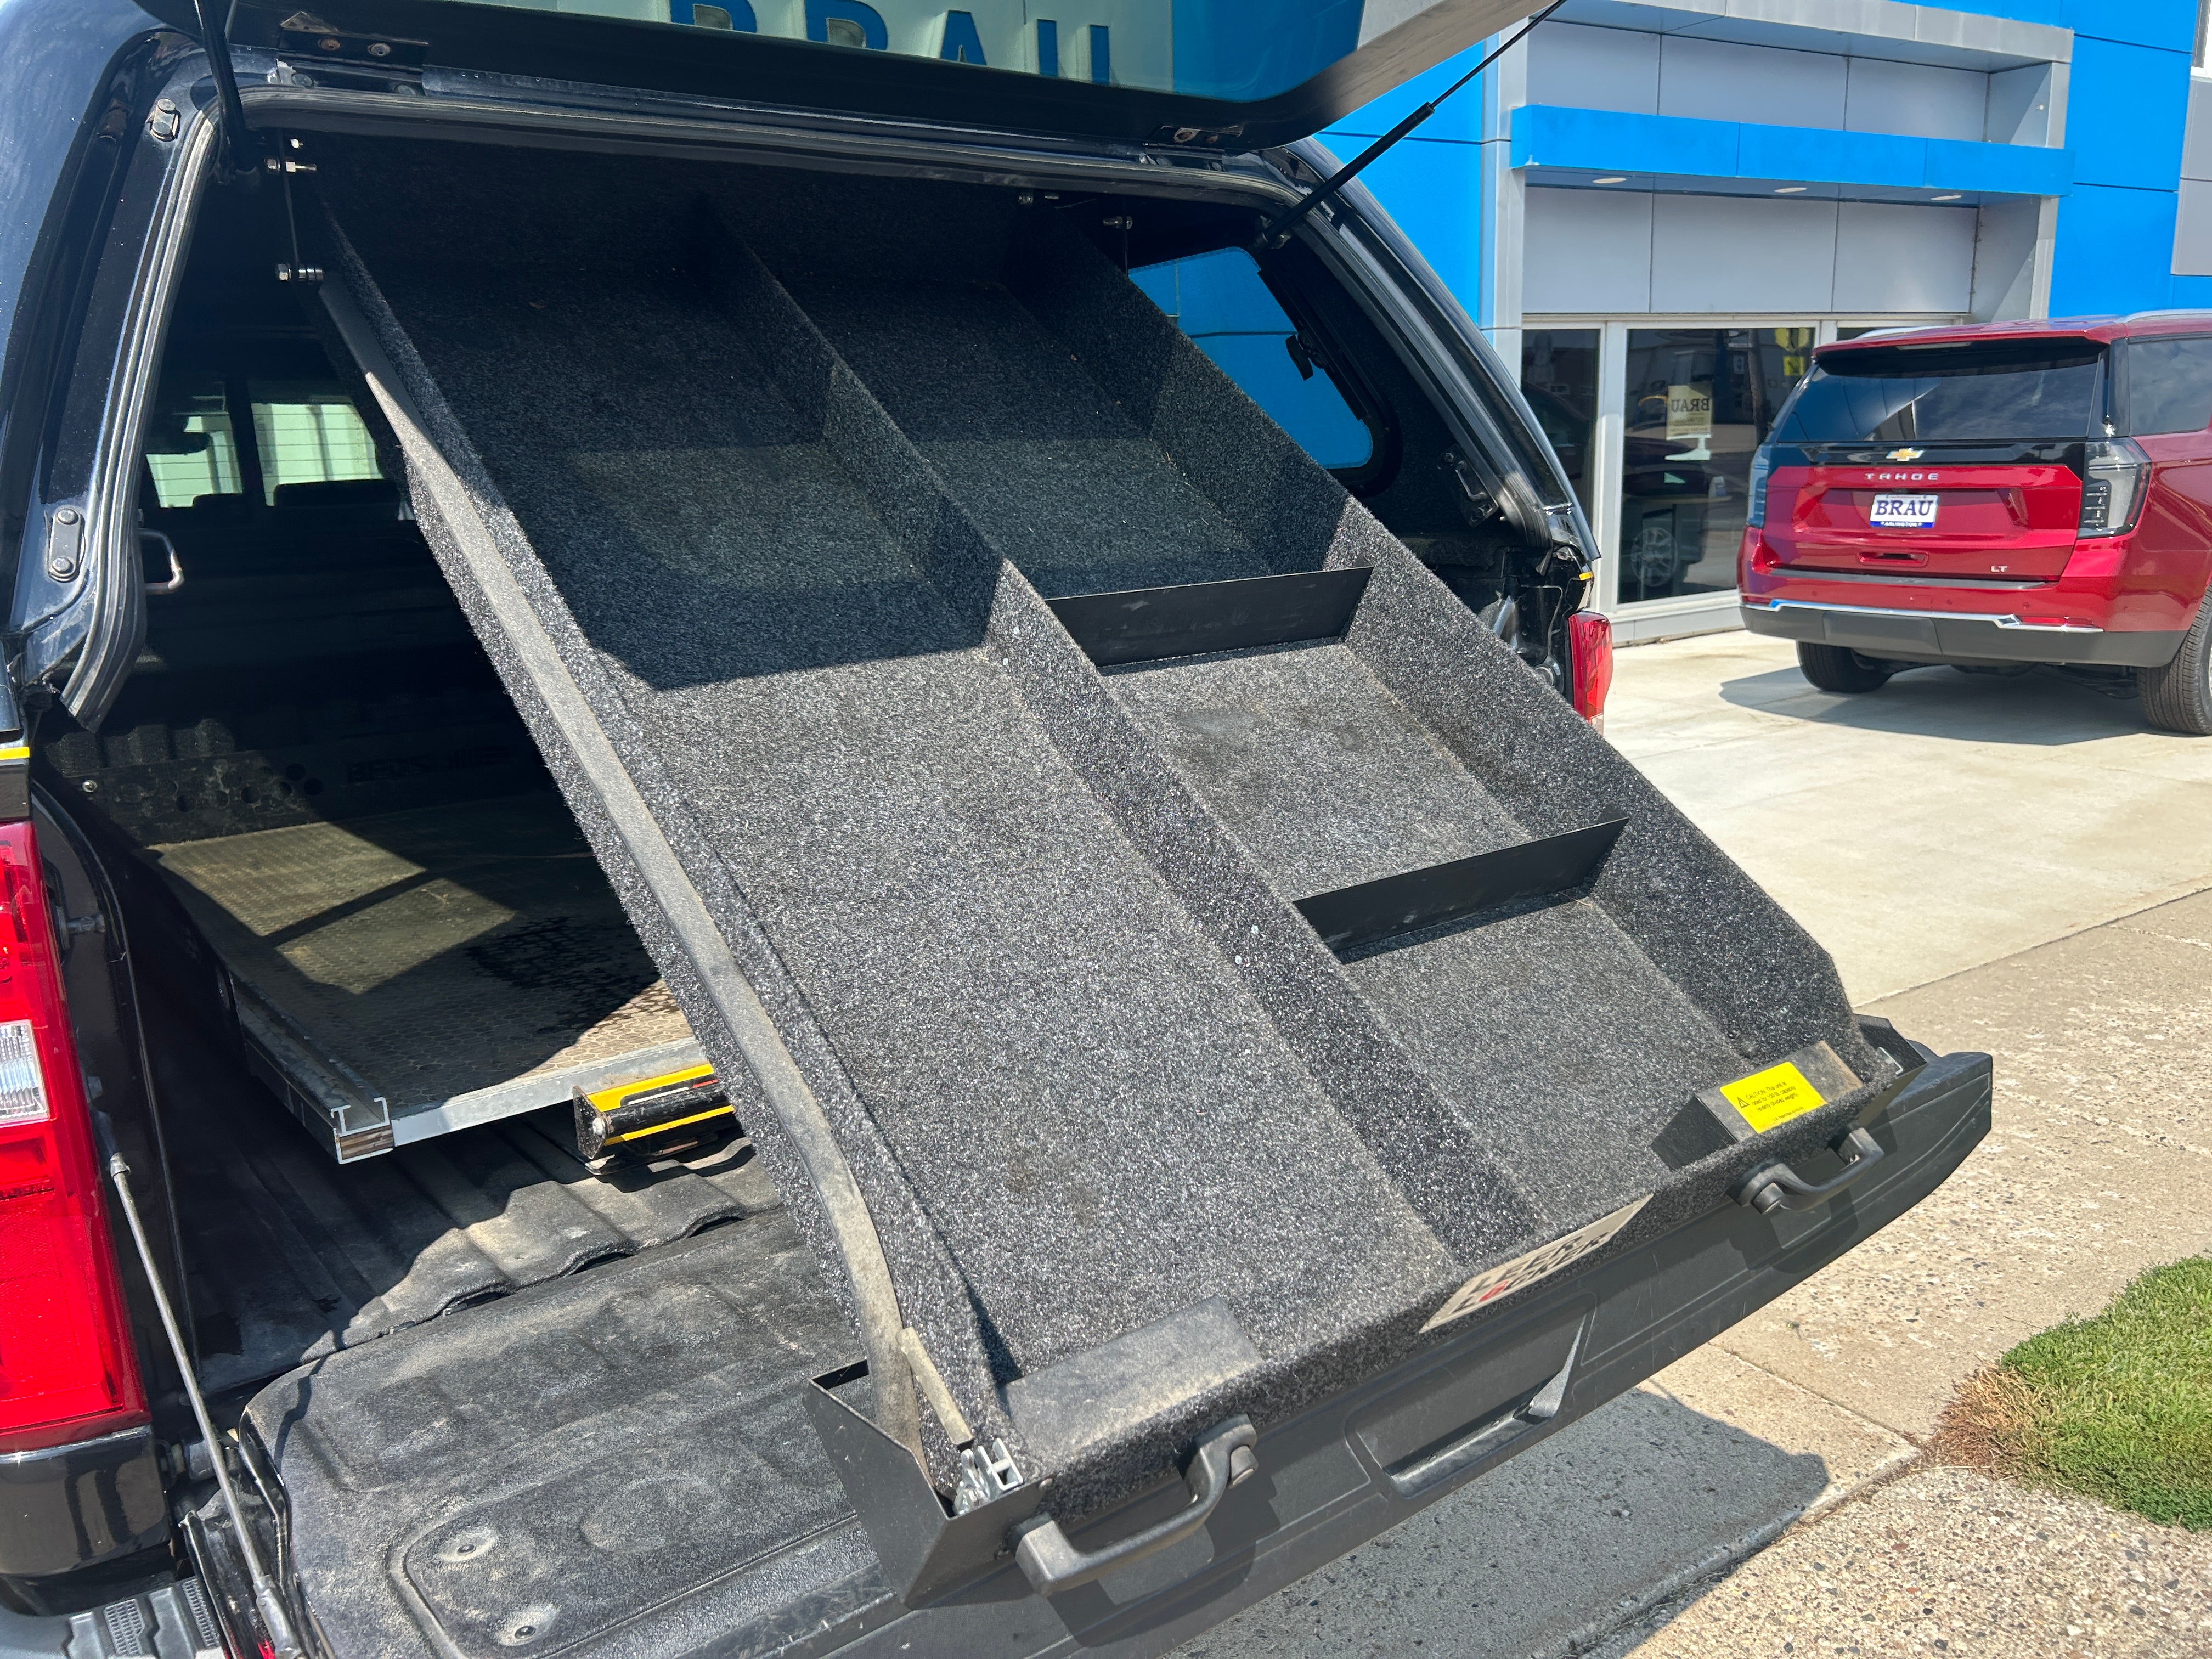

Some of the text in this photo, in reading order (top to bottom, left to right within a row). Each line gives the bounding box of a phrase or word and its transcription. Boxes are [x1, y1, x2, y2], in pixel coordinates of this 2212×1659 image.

[1875, 500, 1934, 516] BRAU
[1449, 1231, 1610, 1314] LOCKER
[1469, 1233, 1584, 1295] LEER
